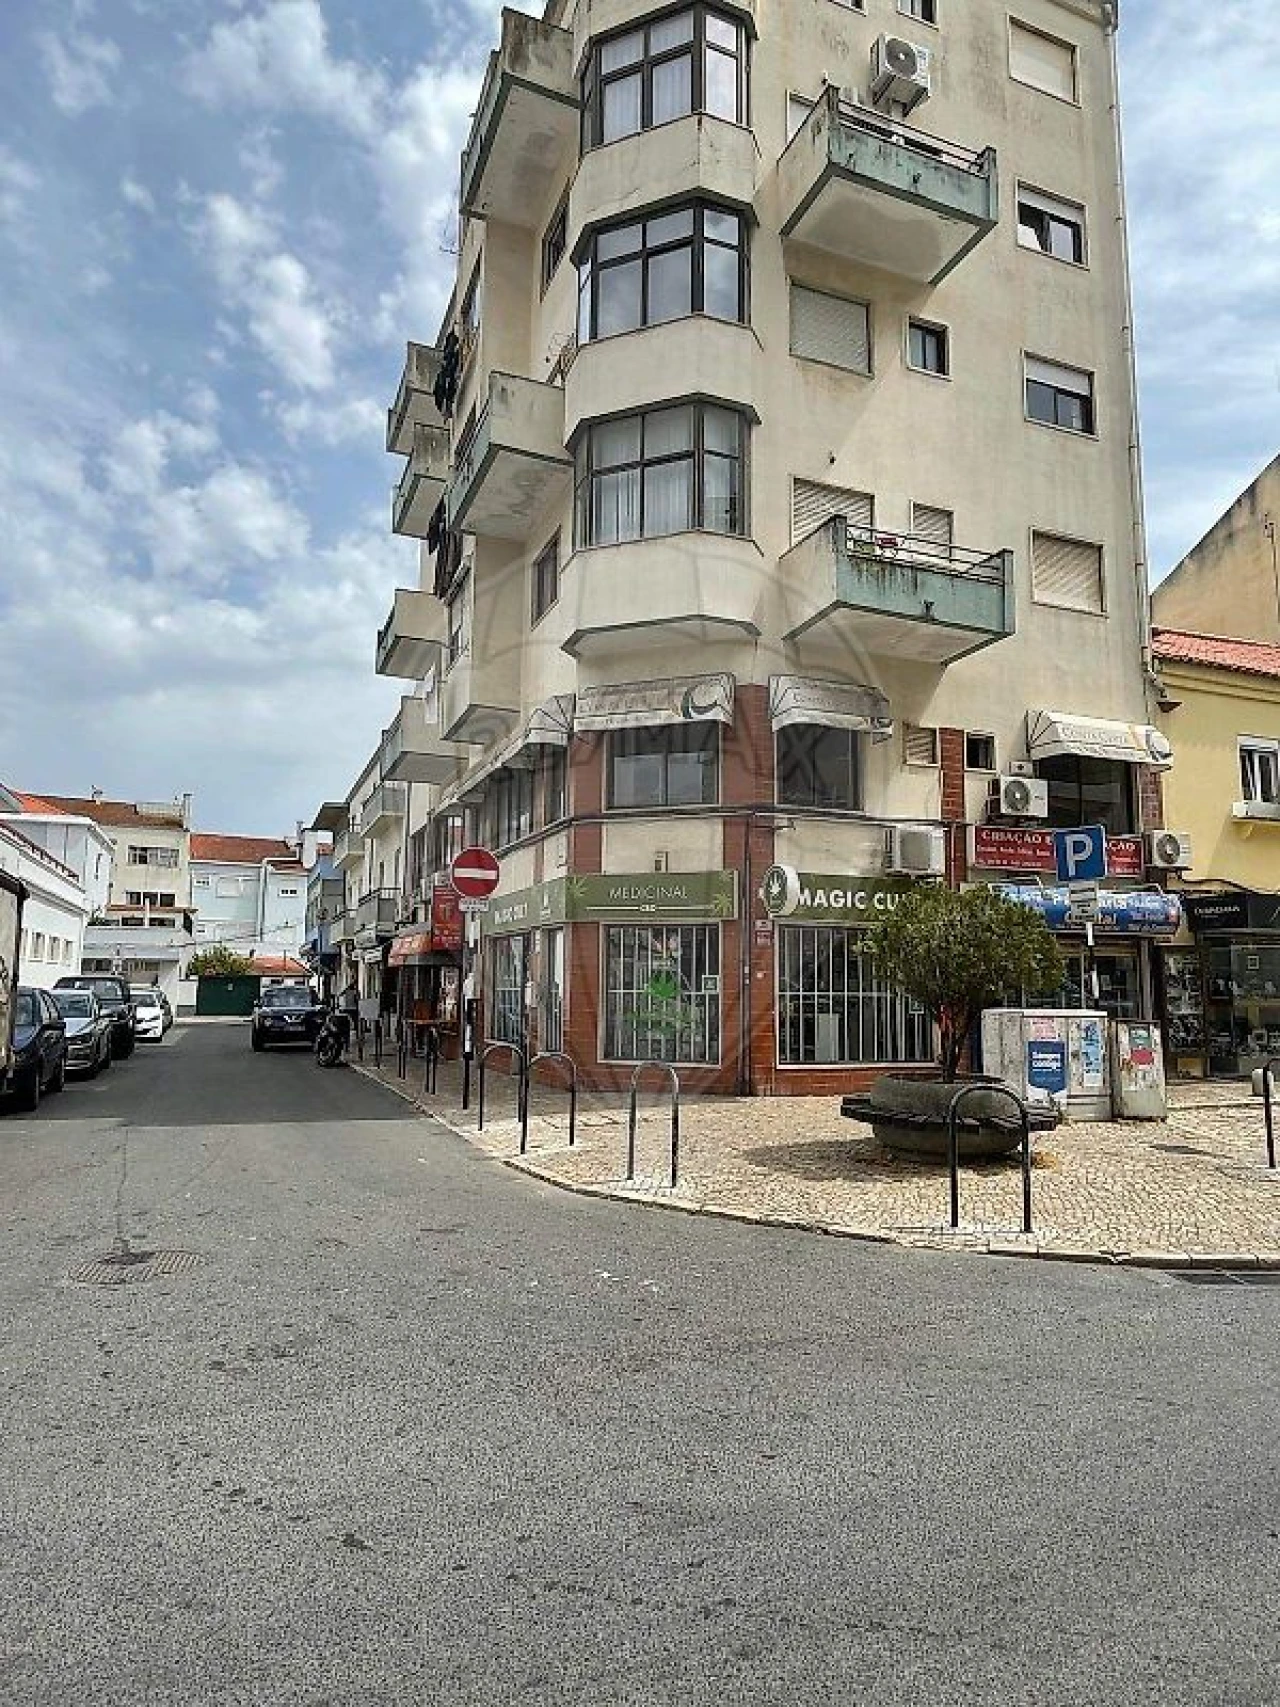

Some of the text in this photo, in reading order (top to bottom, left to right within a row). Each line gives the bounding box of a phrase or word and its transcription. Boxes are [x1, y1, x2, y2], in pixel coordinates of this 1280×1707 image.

[1064, 833, 1094, 878] P
[608, 884, 689, 900] MEDICINAL
[799, 889, 867, 911] MAGIC
